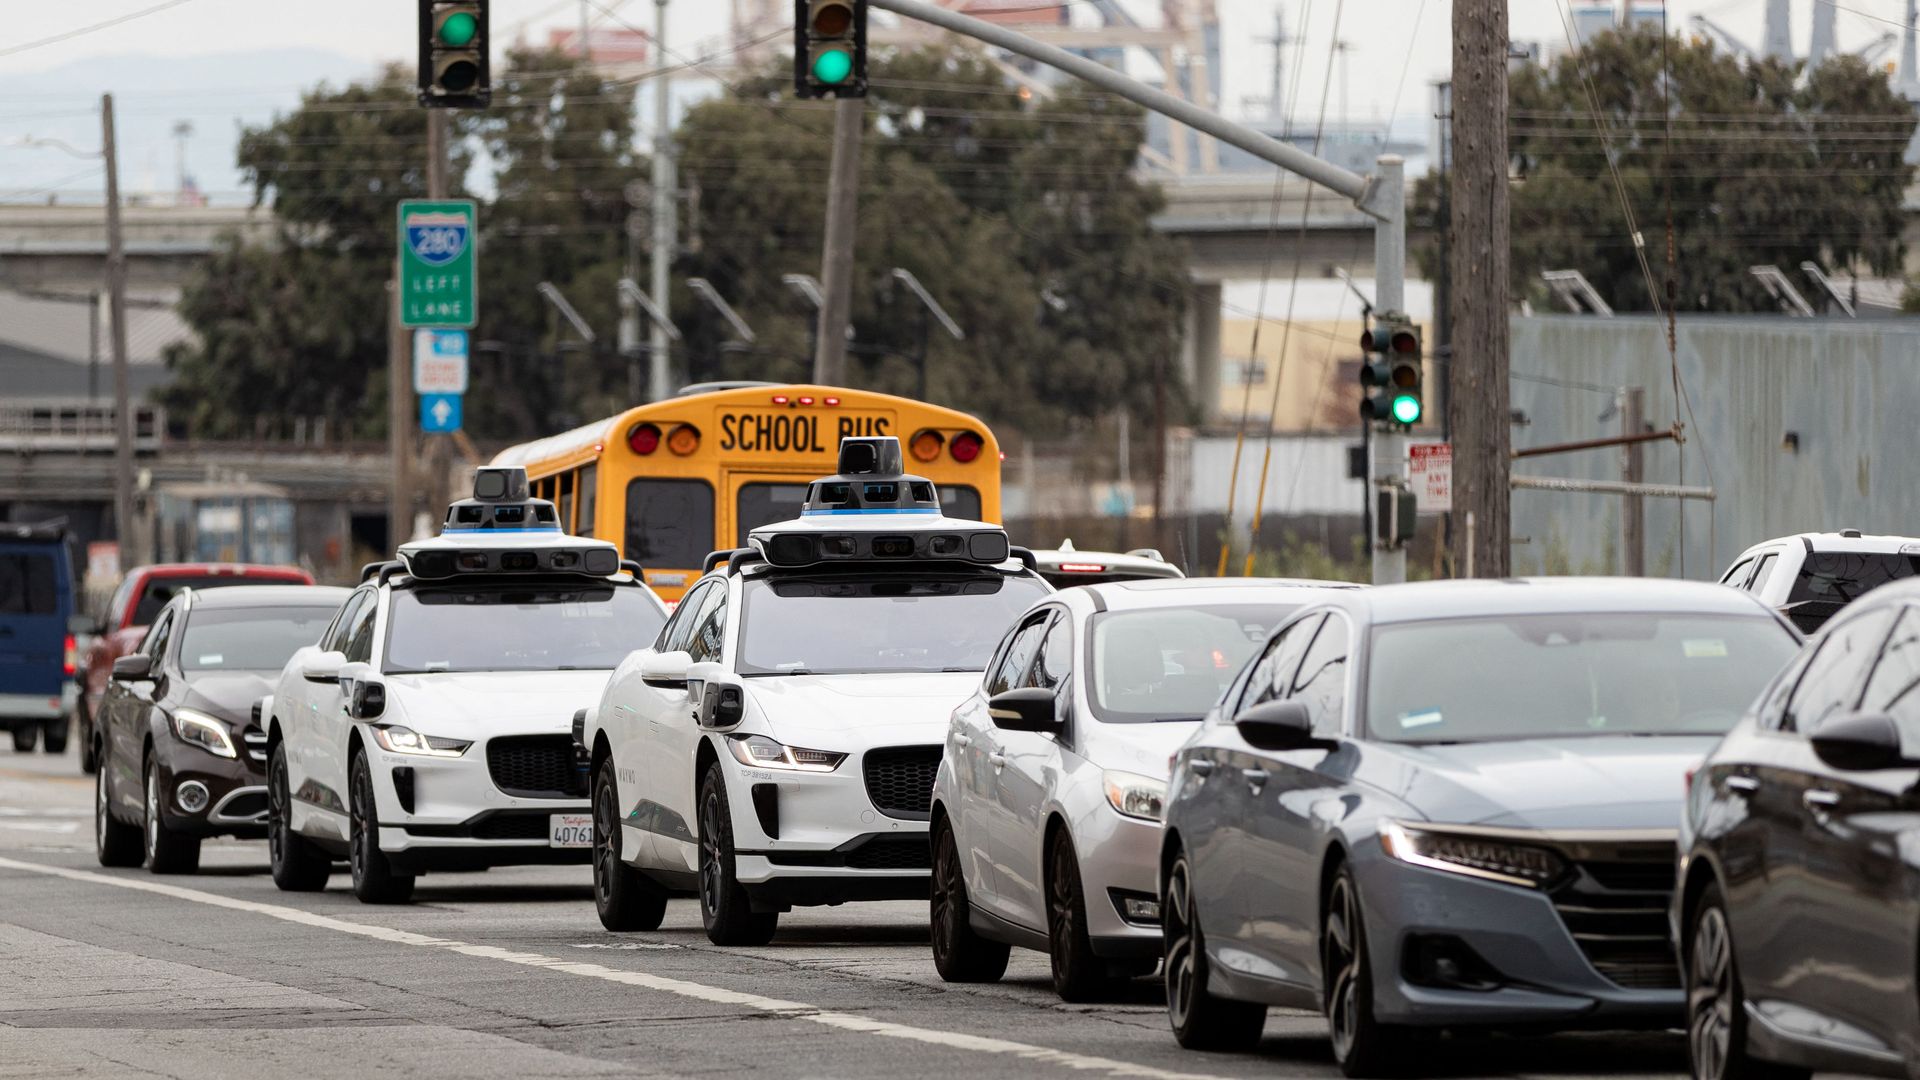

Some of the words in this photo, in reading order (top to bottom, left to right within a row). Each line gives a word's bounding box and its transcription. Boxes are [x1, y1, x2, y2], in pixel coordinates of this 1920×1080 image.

[416, 228, 461, 255] 280
[413, 275, 460, 292] LEFT
[411, 302, 461, 317] LANE
[720, 413, 825, 452] SCHOOL
[1427, 473, 1448, 483] ANY
[1427, 488, 1448, 497] TIME
[554, 827, 593, 842] 40761
